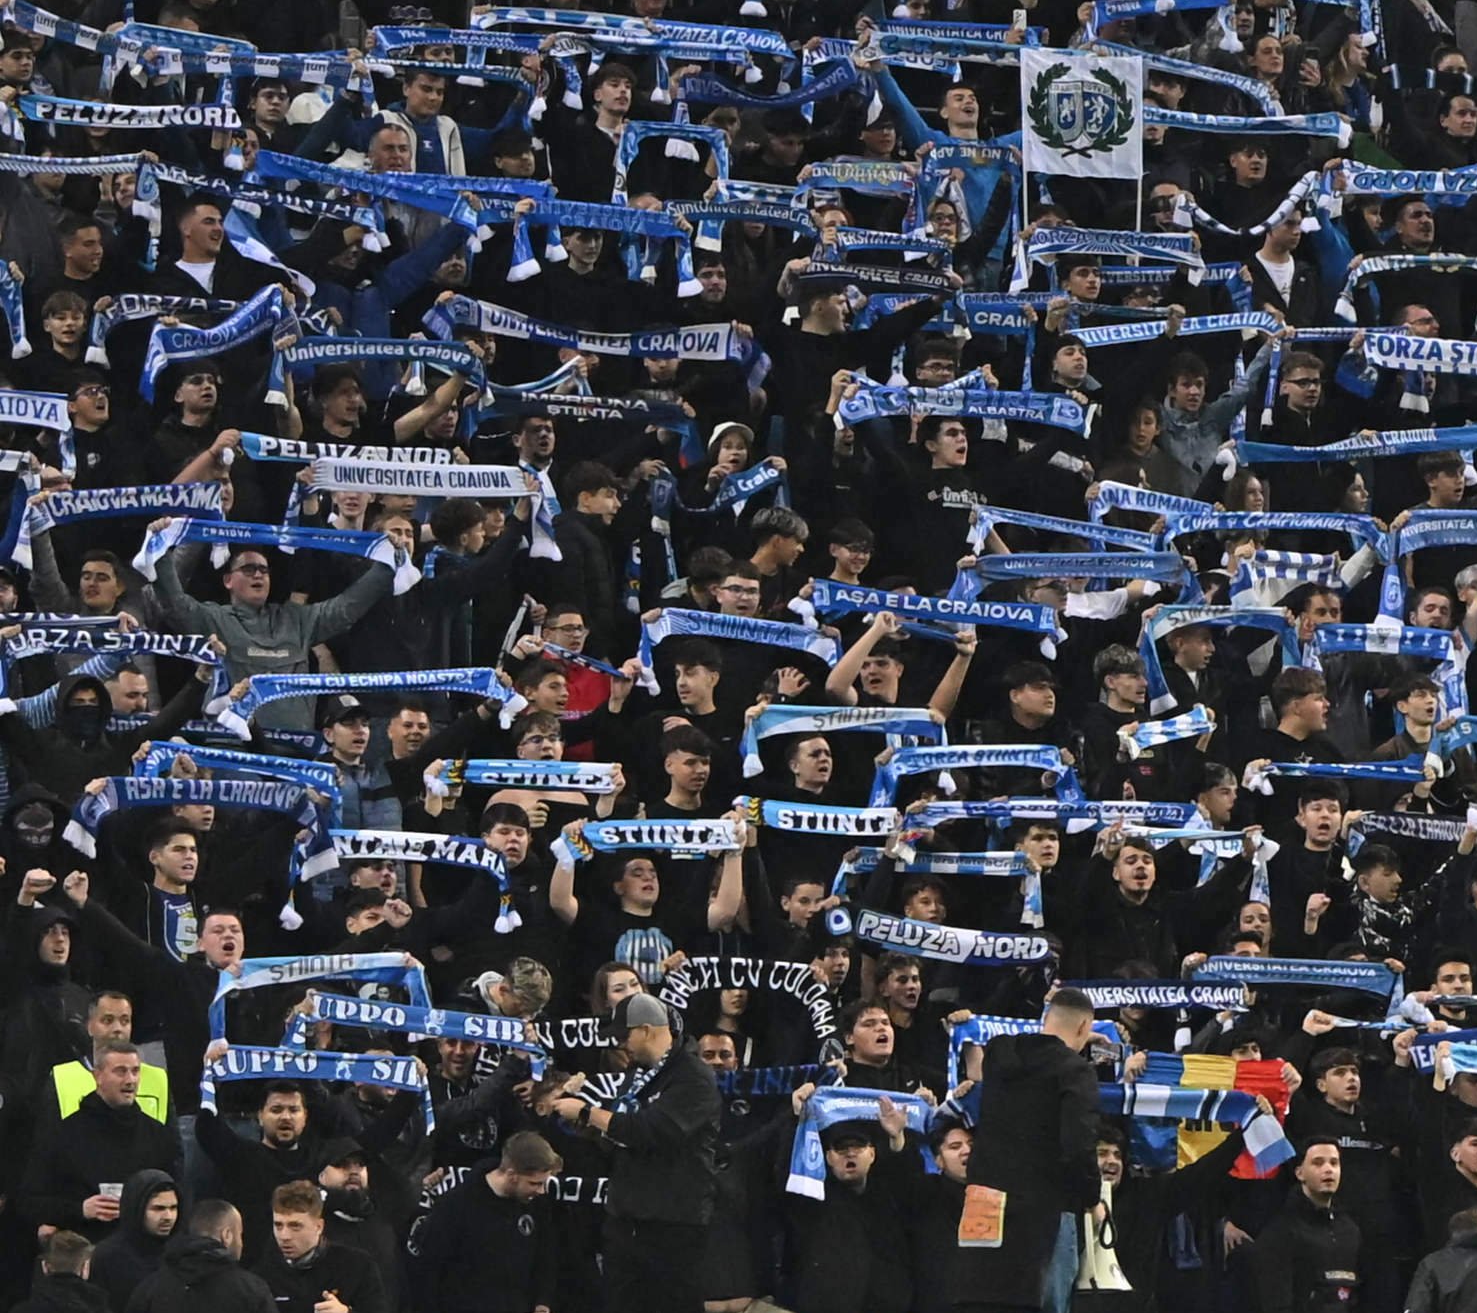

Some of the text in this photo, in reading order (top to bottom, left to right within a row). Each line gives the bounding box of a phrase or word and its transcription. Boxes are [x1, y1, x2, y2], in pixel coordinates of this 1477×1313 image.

[162, 104, 243, 130] NORD
[284, 342, 404, 363] Universitatea
[1365, 333, 1445, 362] FORZA
[333, 465, 512, 489] UNIVERSITATEA CRAIOVA
[901, 595, 932, 615] LA
[938, 596, 1036, 625] CRAIOVA
[856, 908, 1050, 963] PELUZA NORD
